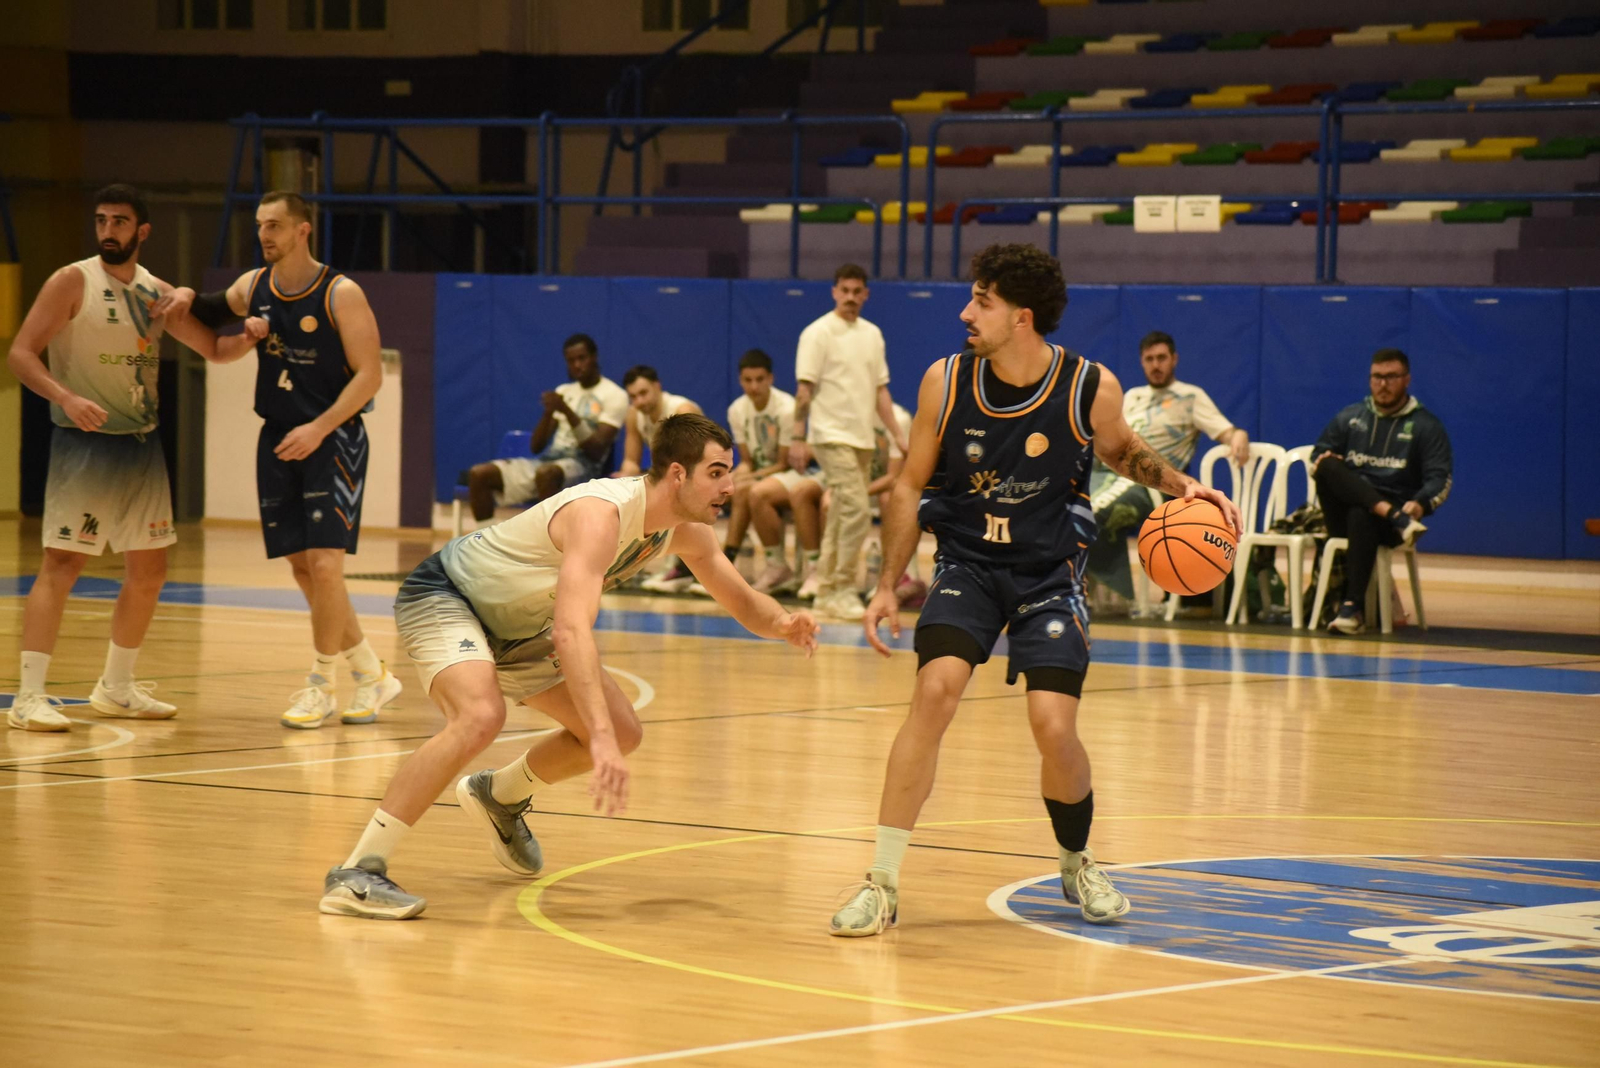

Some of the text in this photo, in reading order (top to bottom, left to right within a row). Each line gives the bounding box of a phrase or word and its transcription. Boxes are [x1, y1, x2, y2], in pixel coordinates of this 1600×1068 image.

[278, 369, 293, 391] 4
[964, 428, 986, 437] vive
[982, 513, 1011, 543] 10
[1203, 530, 1236, 561] ilson
